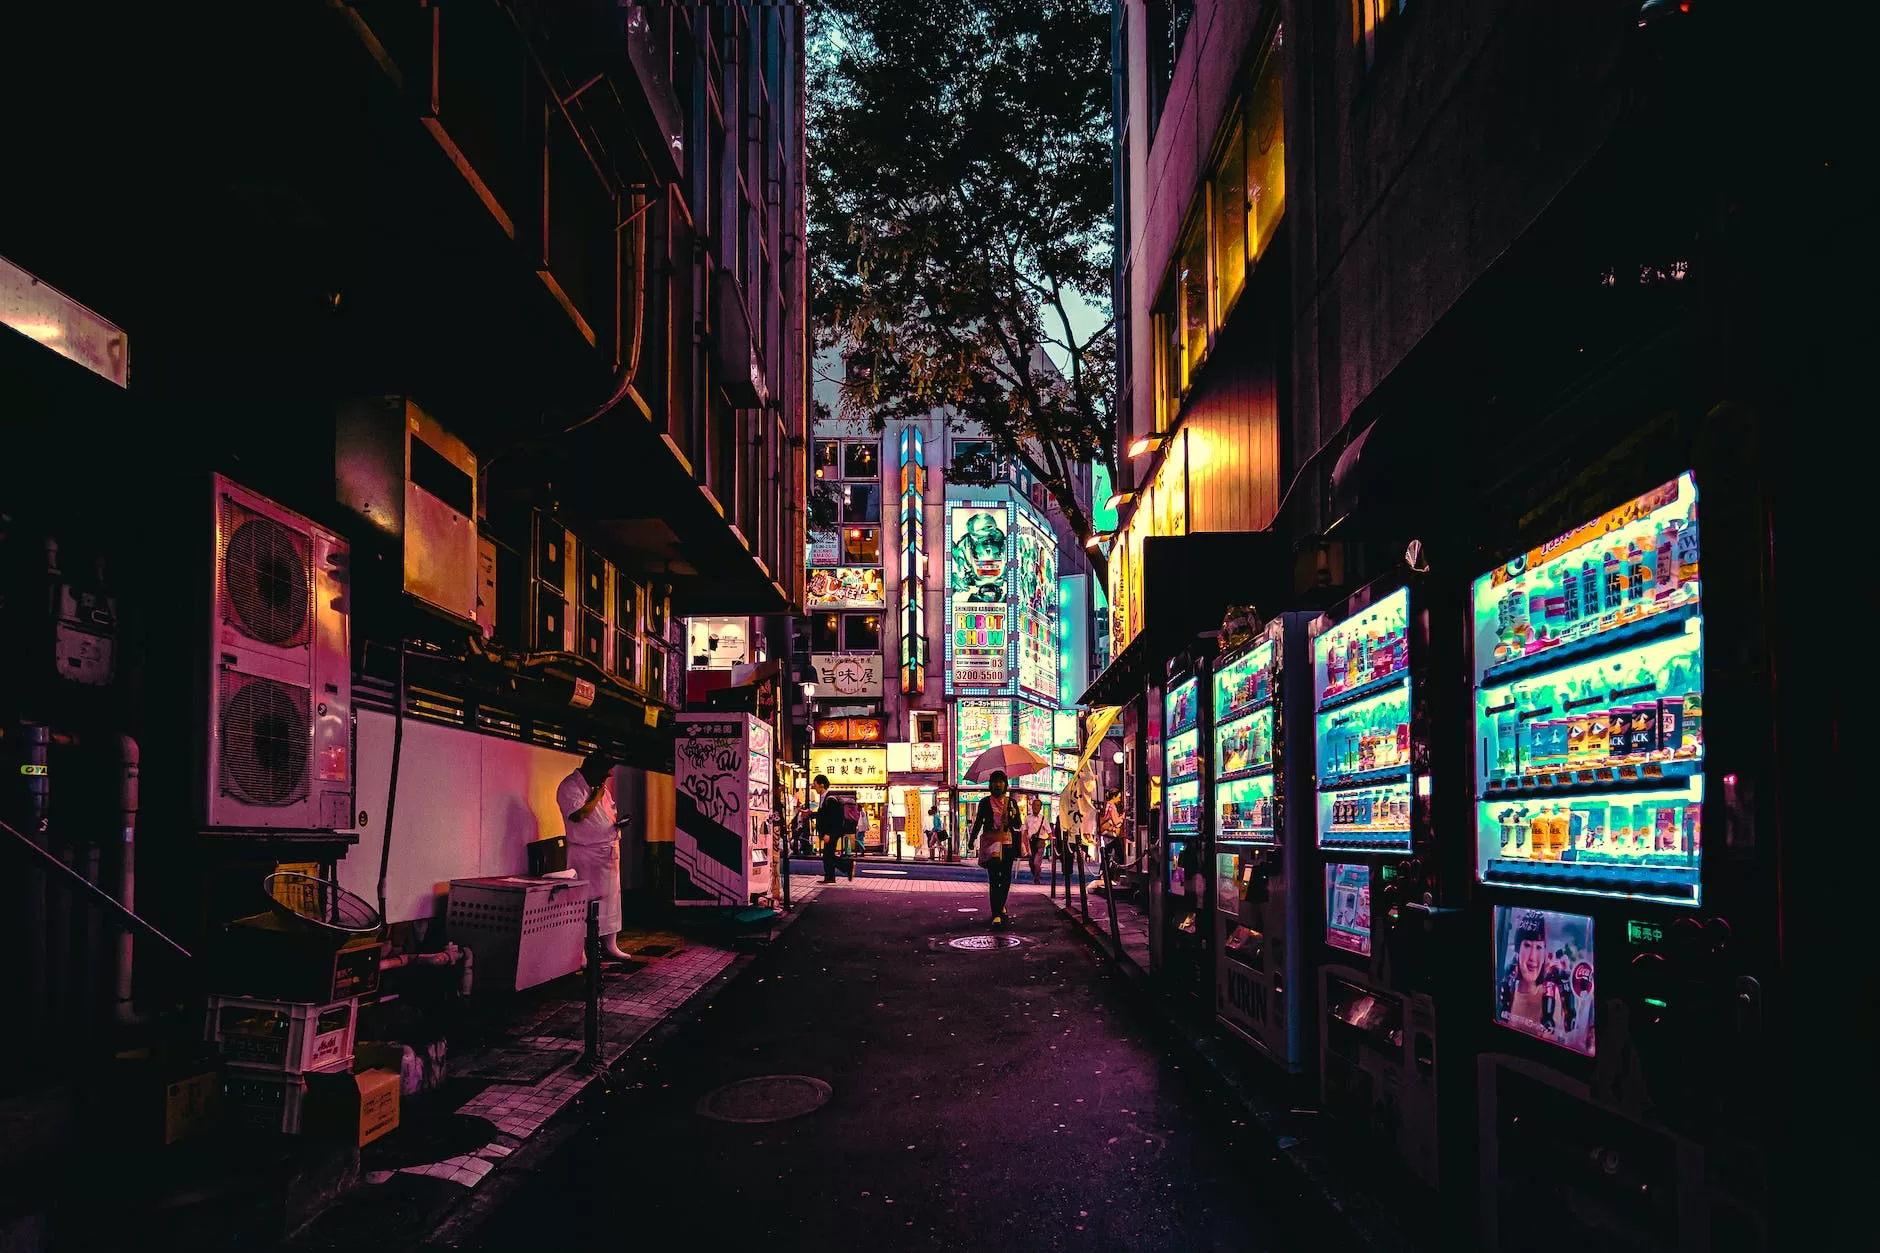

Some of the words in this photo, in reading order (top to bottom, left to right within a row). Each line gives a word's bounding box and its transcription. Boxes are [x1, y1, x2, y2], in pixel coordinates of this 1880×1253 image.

[908, 484, 915, 496] 5
[909, 599, 916, 611] 3
[956, 614, 1004, 630] ROBOT
[956, 630, 1004, 645] SHOW
[909, 658, 916, 670] 2
[991, 659, 1003, 668] 03
[821, 667, 877, 685] 旨味屋
[1631, 925, 1664, 943] 販売中
[1227, 966, 1268, 1028] KIRIN
